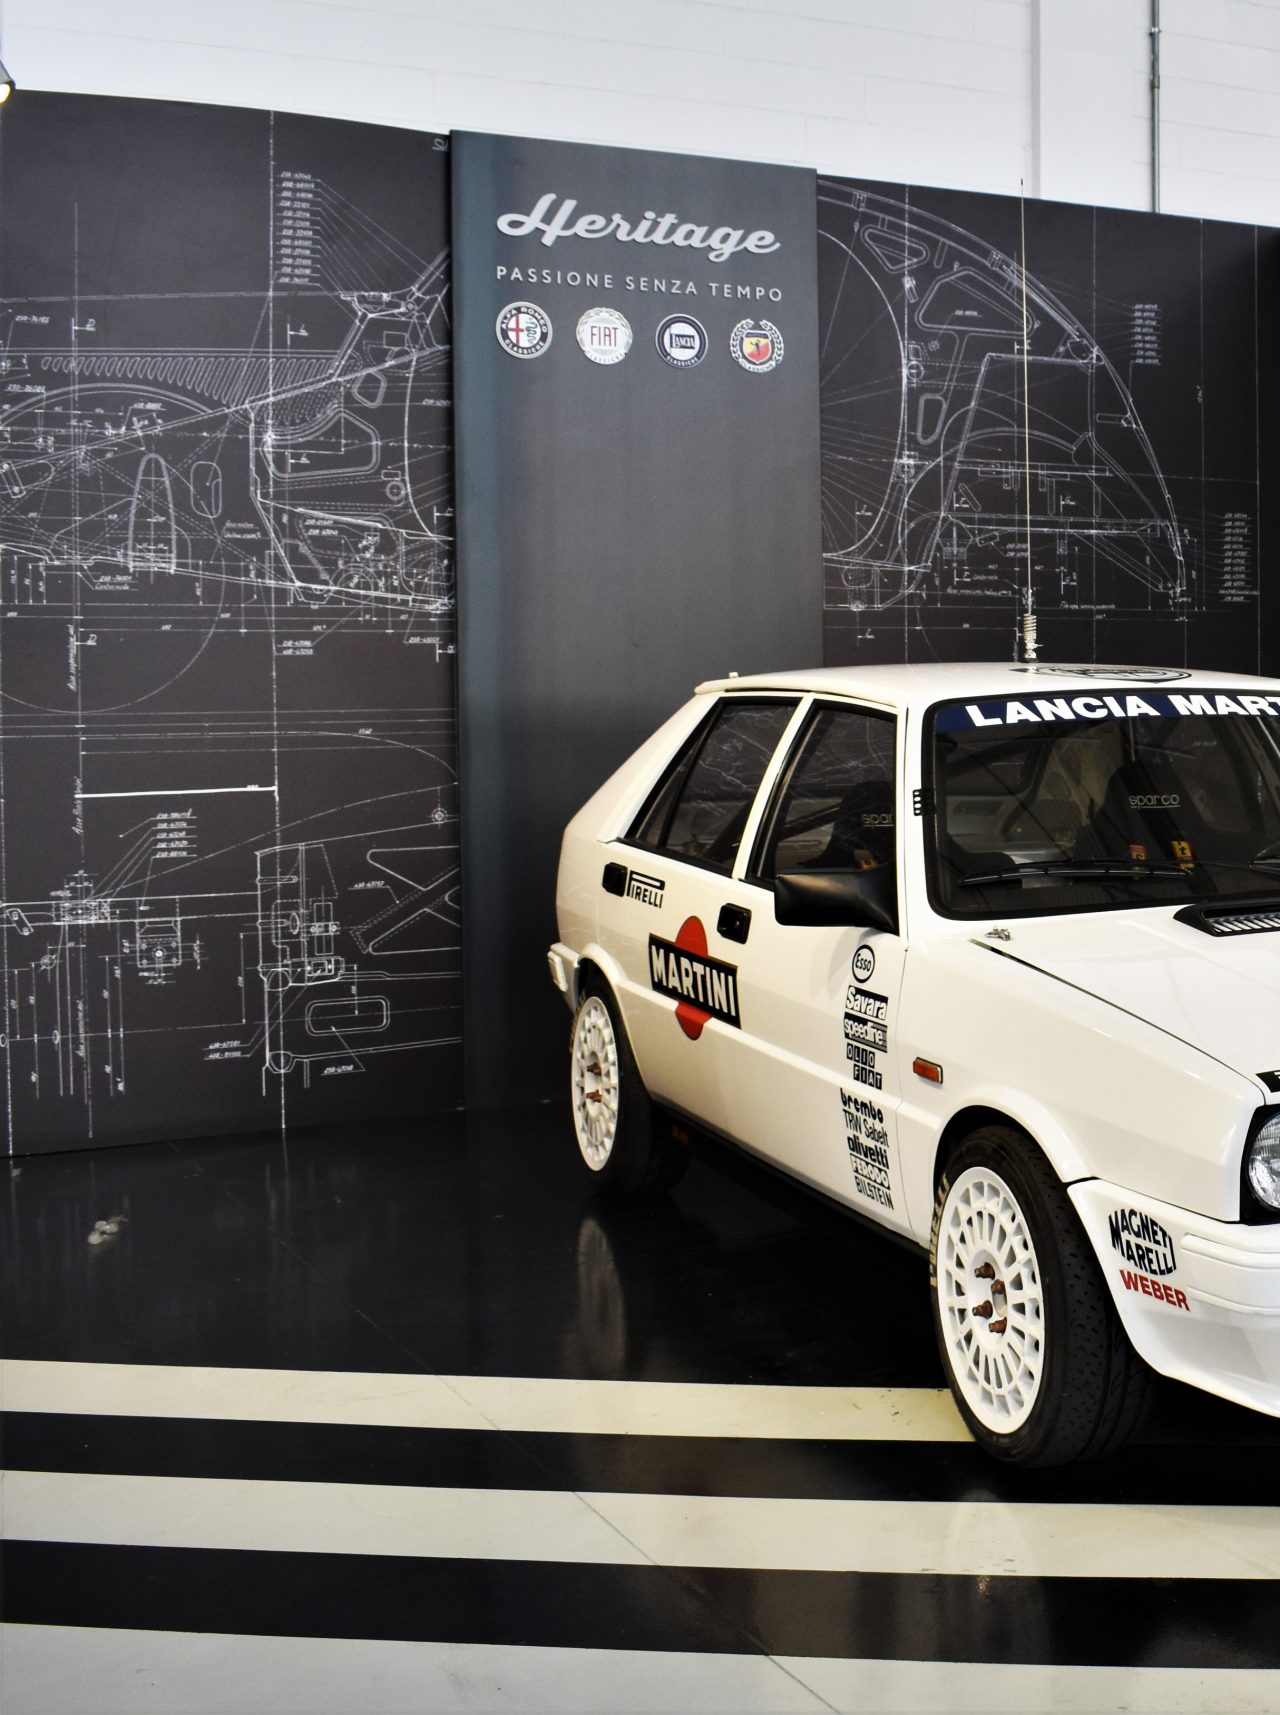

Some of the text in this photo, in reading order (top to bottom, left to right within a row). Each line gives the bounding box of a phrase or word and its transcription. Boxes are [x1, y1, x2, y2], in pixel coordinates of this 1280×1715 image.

[496, 192, 782, 262] Heritage
[496, 265, 783, 302] PASSIONE SENZA TEMPO
[500, 306, 548, 334] ALFA ROMEO
[590, 325, 619, 347] FIAT
[965, 694, 1161, 728] LANCIA
[1129, 793, 1180, 808] sparco
[626, 869, 666, 909] PIRELLI
[855, 952, 872, 972] Esso
[651, 944, 737, 1017] MARTINI
[846, 985, 888, 1021] Savara
[846, 1042, 875, 1069] OLIO
[853, 1063, 882, 1091] FIAT
[840, 1087, 884, 1124] brembo
[847, 1134, 890, 1170] olivetti
[854, 1175, 895, 1210] BILSTEIN
[1119, 1268, 1191, 1312] WEBER
